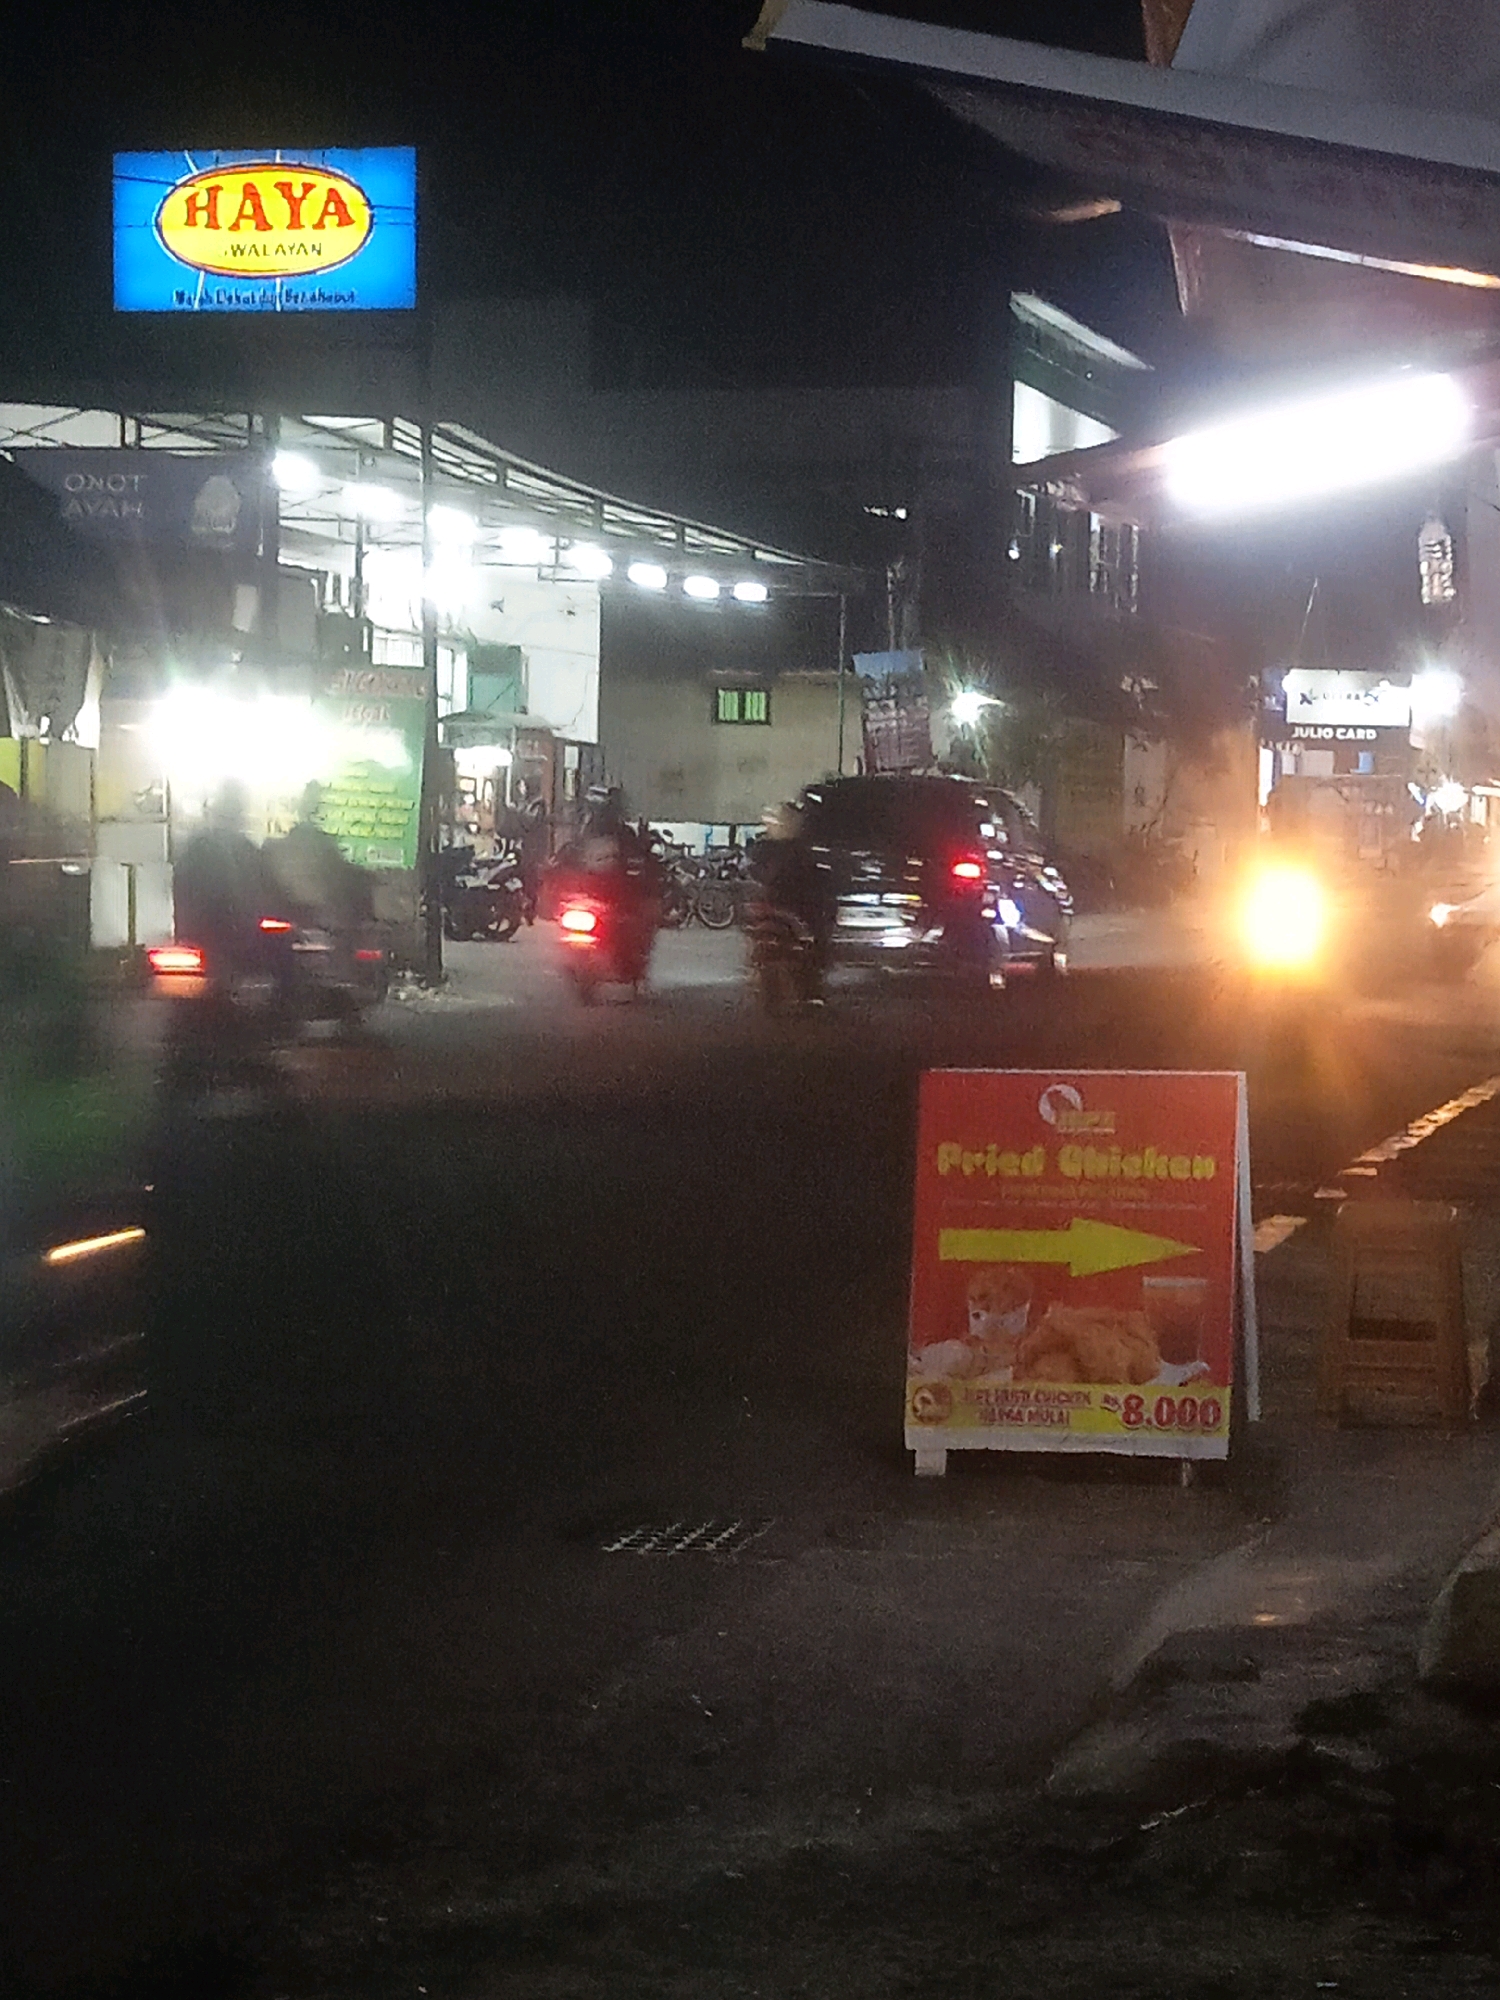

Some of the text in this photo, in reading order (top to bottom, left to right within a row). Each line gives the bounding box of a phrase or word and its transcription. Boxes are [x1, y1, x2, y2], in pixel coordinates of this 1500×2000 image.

[183, 182, 356, 231] HAYA
[231, 243, 322, 257] WALAYAN
[1291, 726, 1377, 740] JULIO CARD
[937, 1142, 1215, 1180] Fried Chicken
[1121, 1393, 1222, 1429] 8.000
